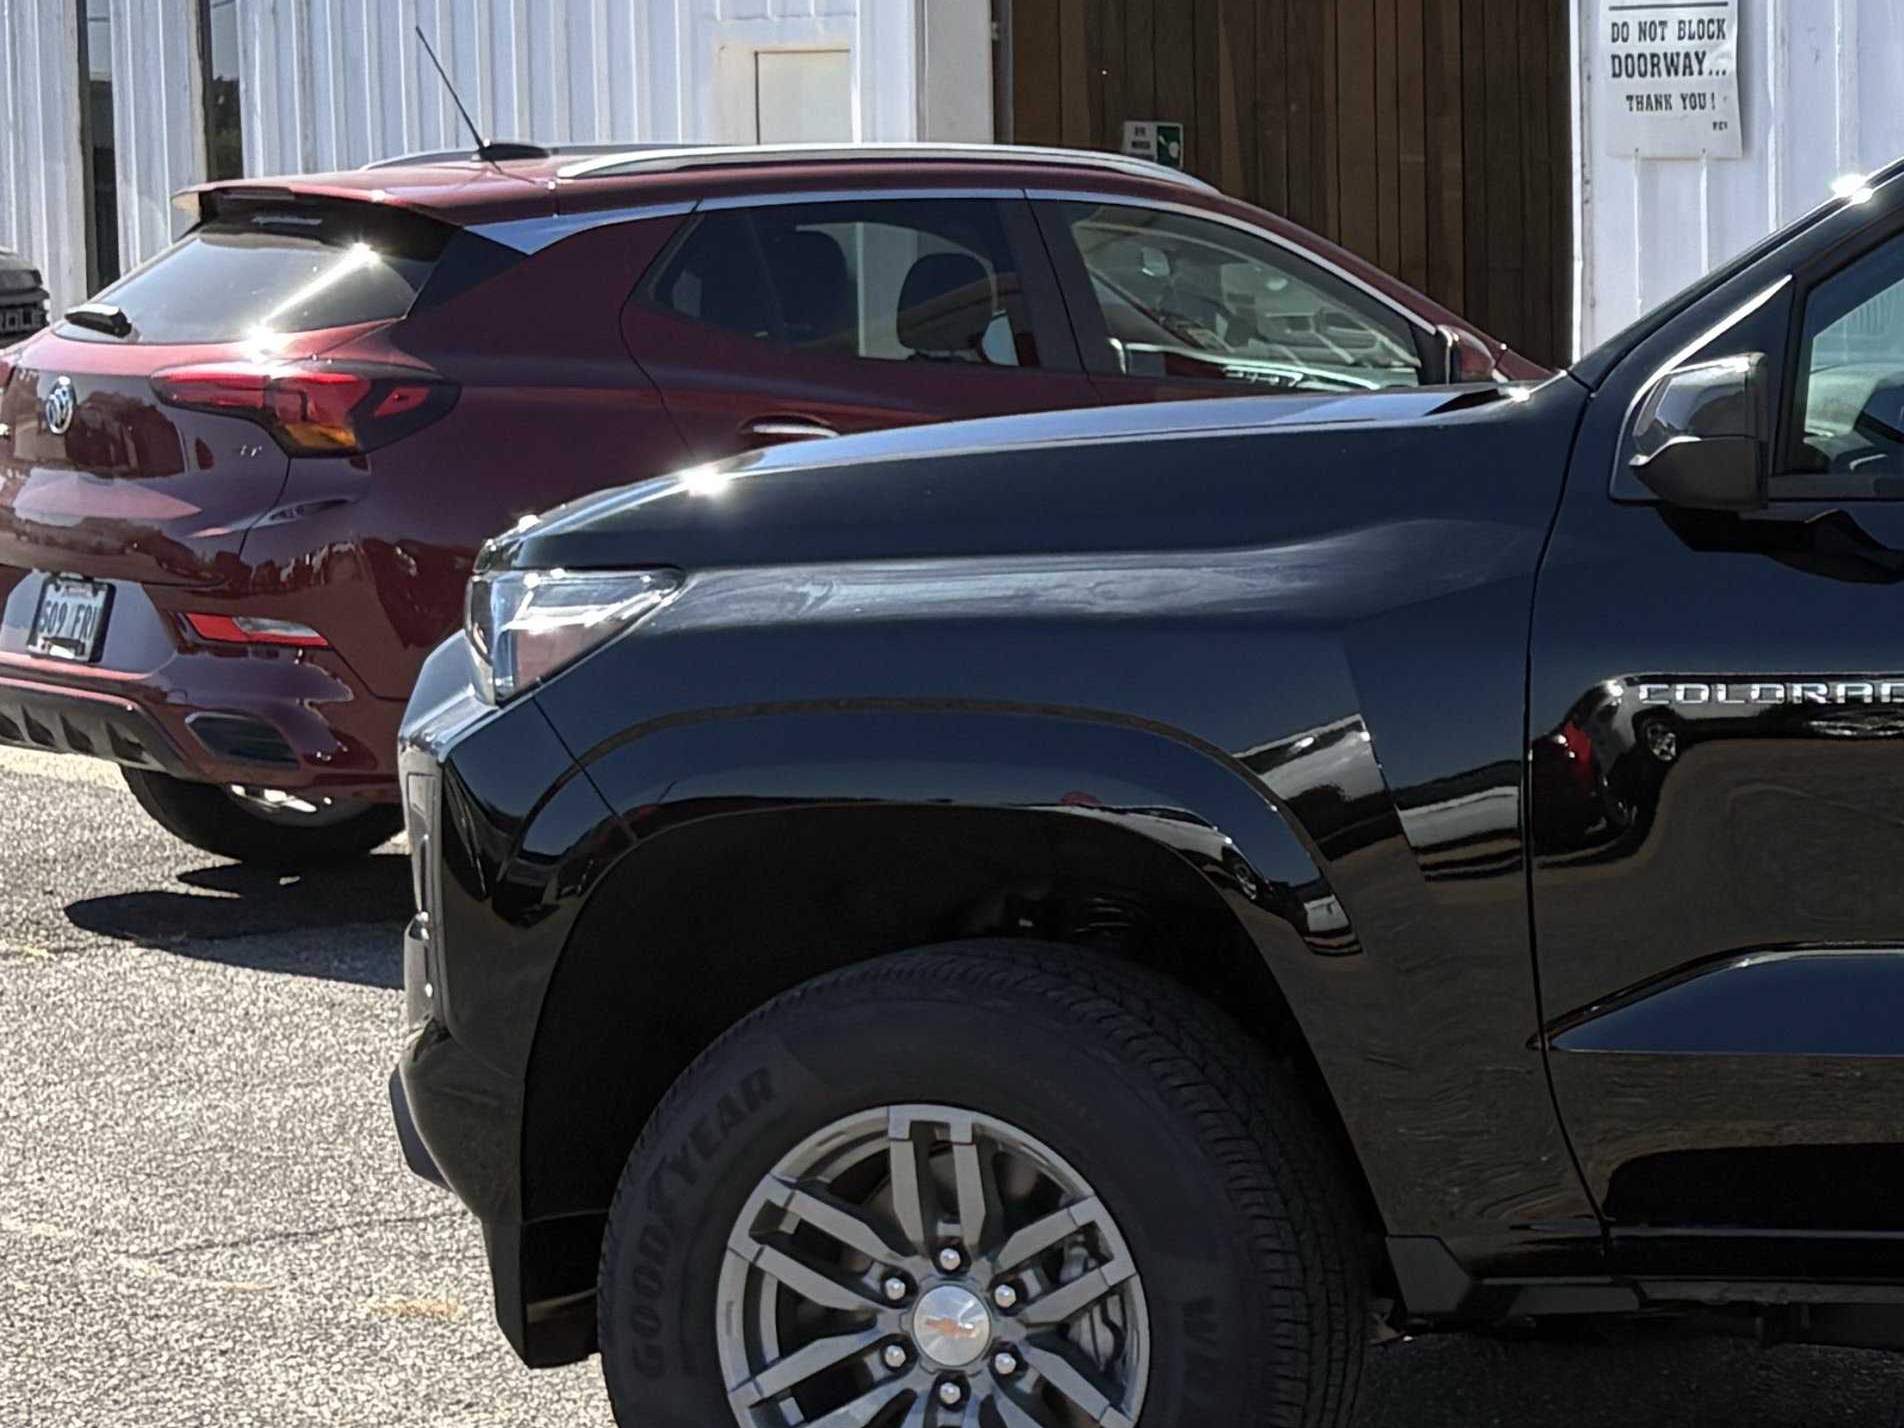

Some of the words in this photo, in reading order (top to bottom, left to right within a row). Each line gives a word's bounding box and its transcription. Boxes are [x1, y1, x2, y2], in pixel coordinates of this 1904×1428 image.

[1611, 22, 1630, 43] DO
[1638, 21, 1668, 42] NOT
[1677, 18, 1727, 41] BLOCK
[1611, 50, 1727, 79] DOORWAY...
[1626, 94, 1673, 112] THANK
